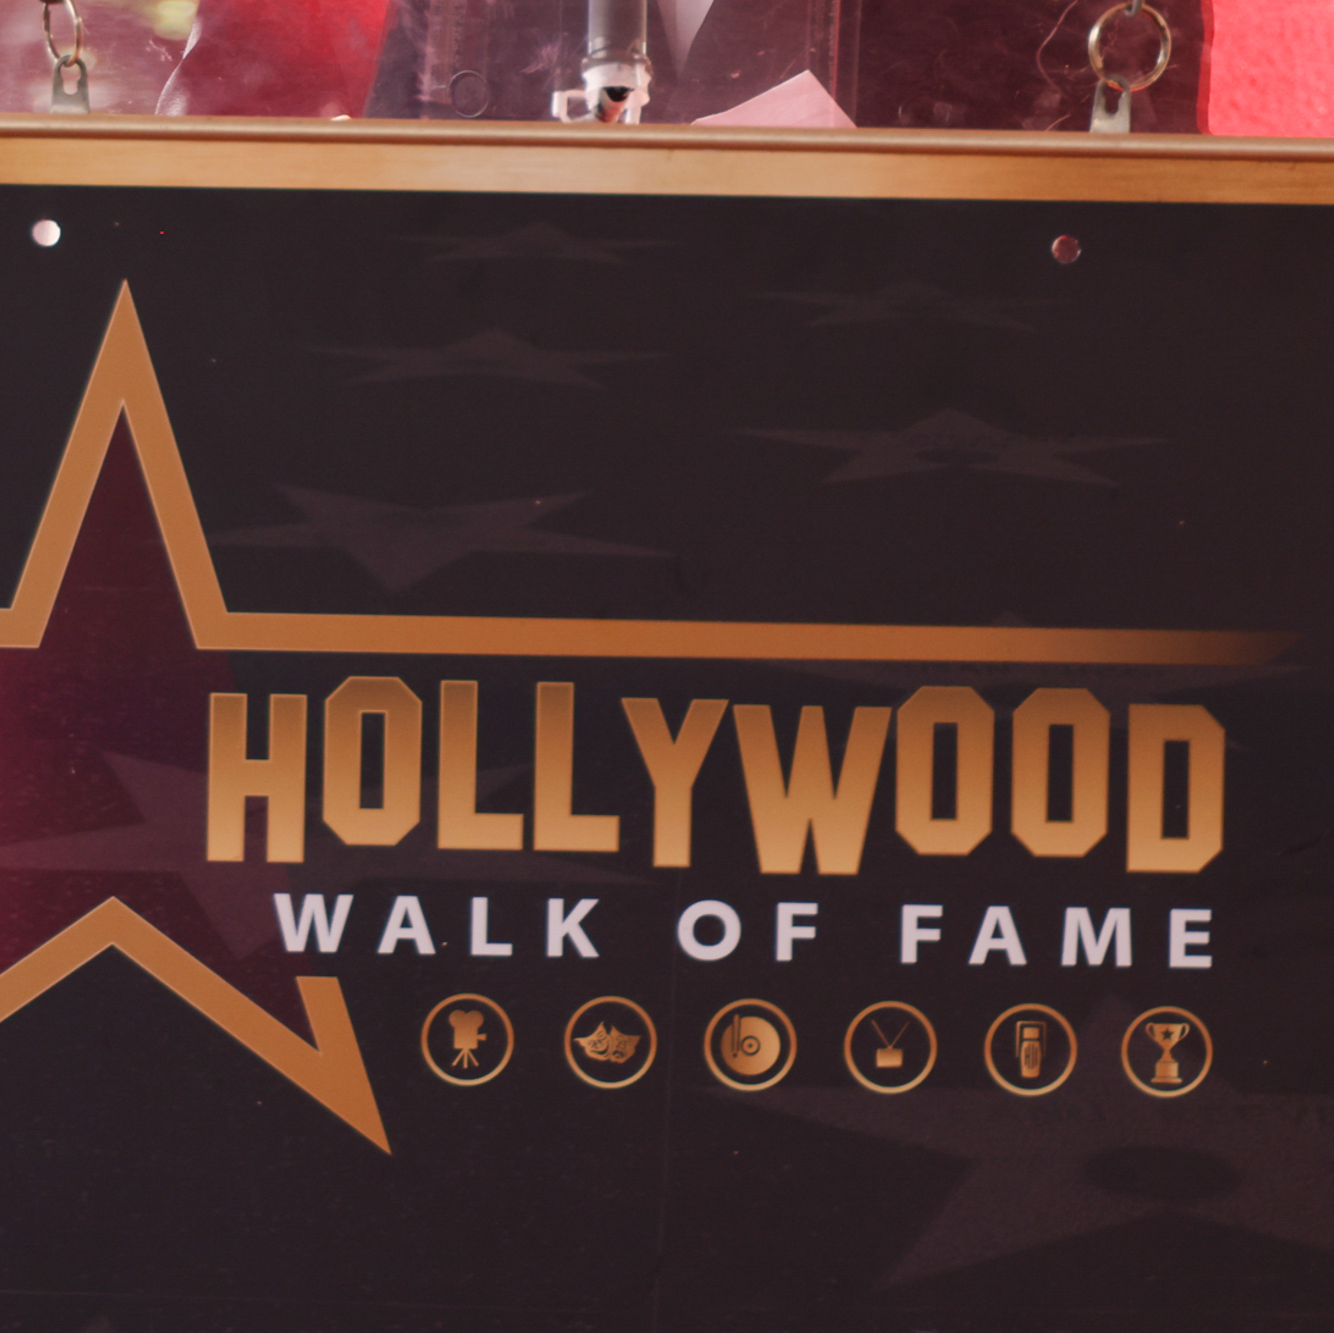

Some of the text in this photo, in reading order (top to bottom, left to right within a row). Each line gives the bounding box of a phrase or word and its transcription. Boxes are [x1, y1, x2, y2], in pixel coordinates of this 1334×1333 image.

[205, 675, 1226, 876] HOLLYWOOD
[273, 892, 1214, 968] WALK OF FAME
